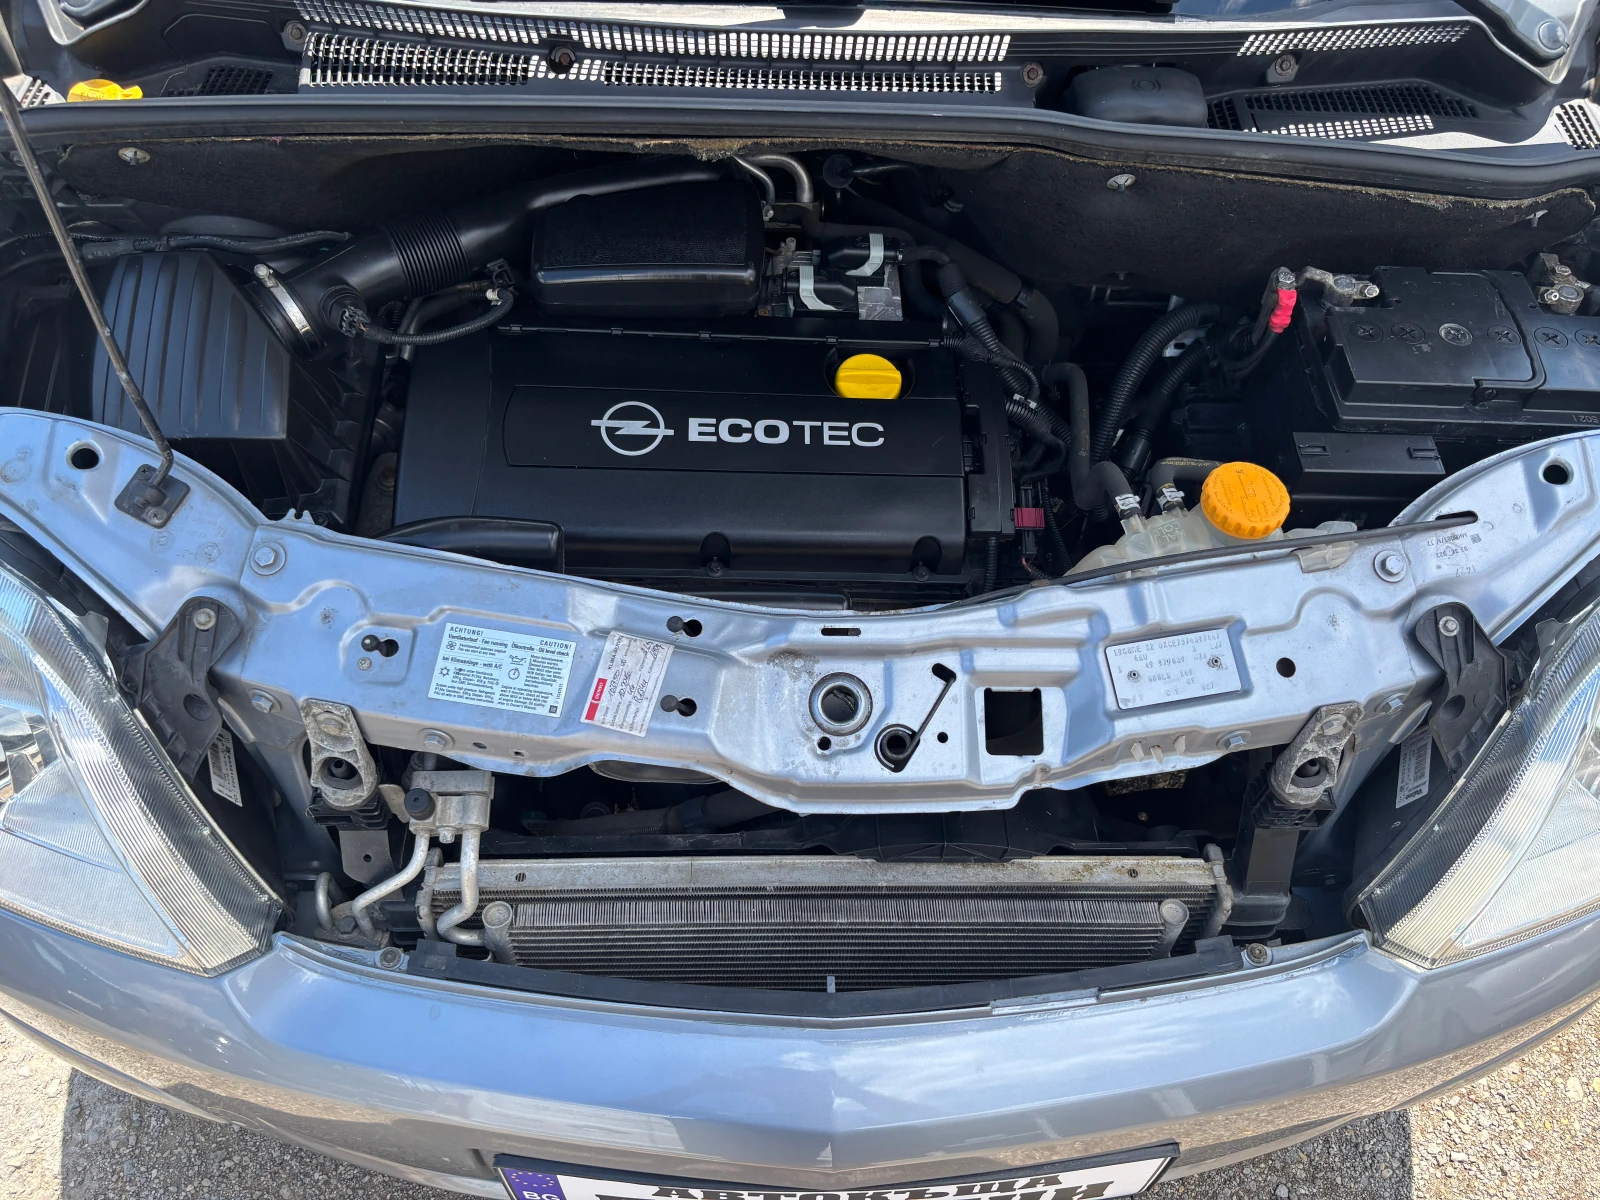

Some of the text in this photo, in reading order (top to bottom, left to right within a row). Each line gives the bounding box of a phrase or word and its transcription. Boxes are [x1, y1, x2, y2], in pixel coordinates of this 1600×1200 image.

[688, 417, 885, 447] ECOTEC
[449, 625, 484, 636] ACHTUNG!
[539, 639, 571, 649] CAUTION!
[594, 681, 604, 699] DENSO
[522, 1190, 561, 1200] BG
